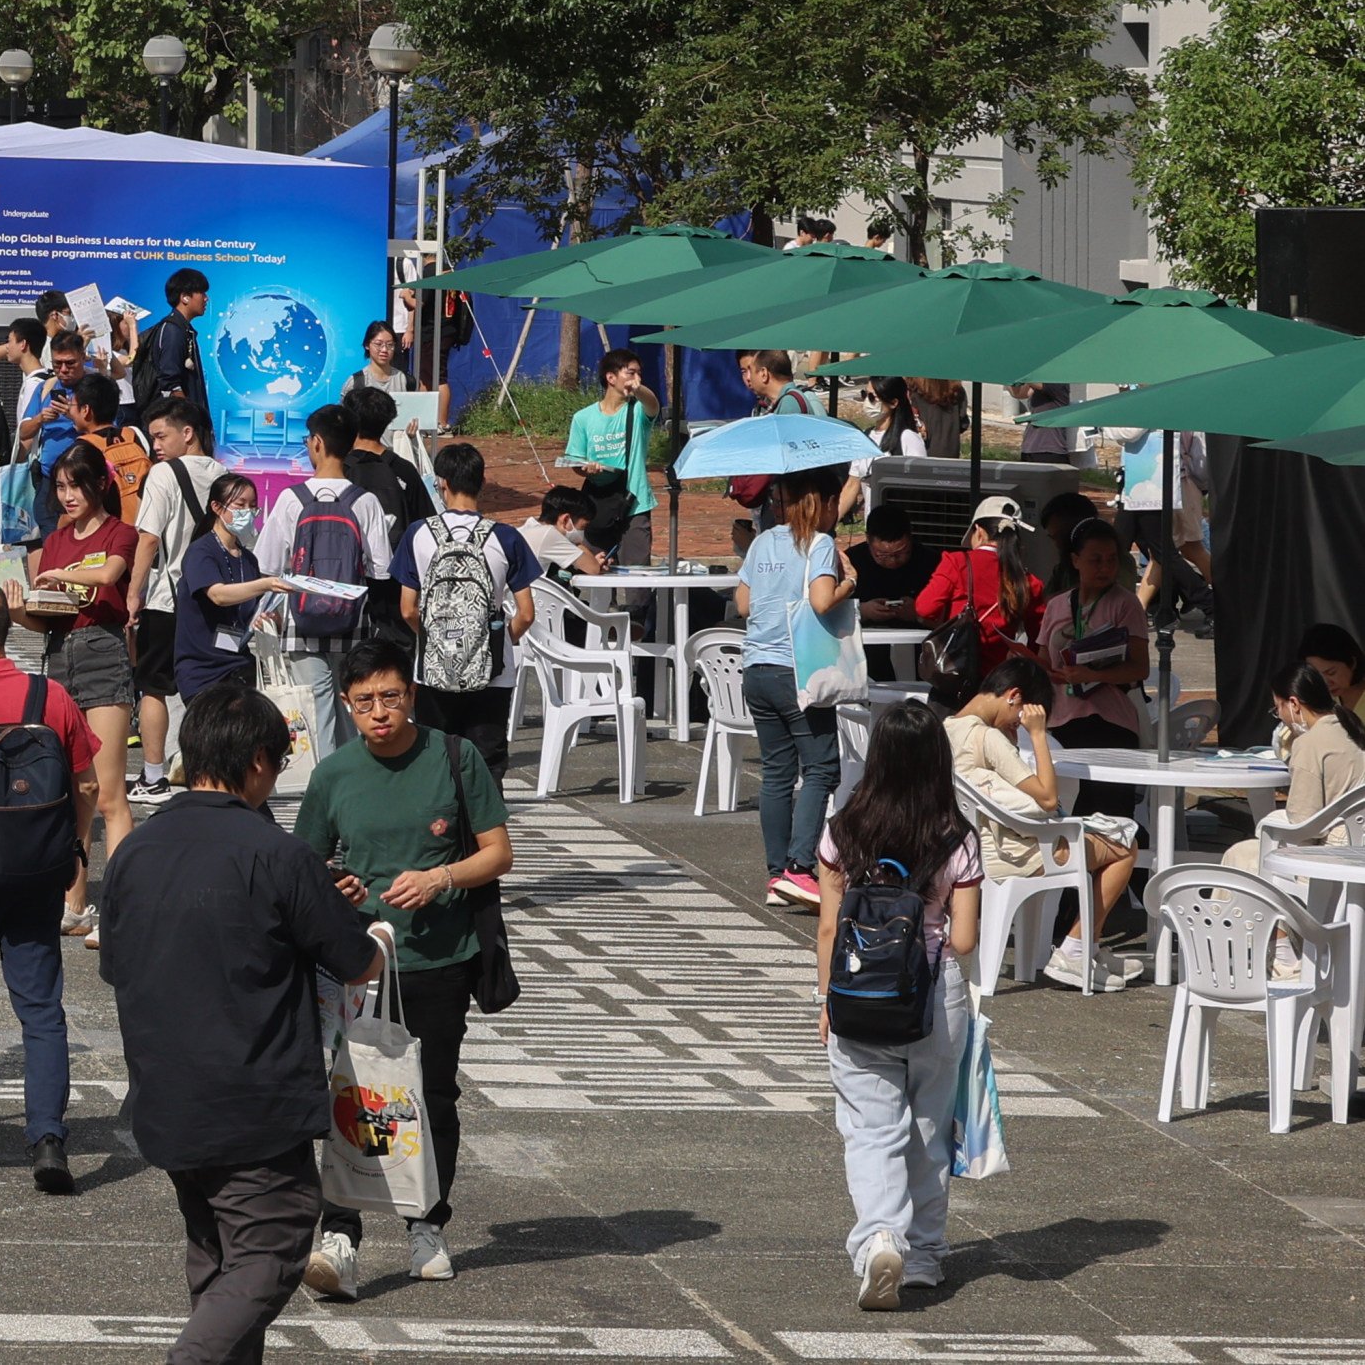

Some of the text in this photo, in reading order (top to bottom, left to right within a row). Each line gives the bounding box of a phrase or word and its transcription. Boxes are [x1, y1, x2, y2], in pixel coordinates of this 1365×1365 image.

[3, 210, 49, 219] Undergraduate
[20, 234, 53, 243] Global
[56, 235, 101, 245] Business
[104, 236, 144, 246] Leaders
[147, 237, 160, 246] for
[163, 237, 181, 247] the
[183, 238, 212, 248] Asian
[214, 239, 256, 251] Century
[20, 248, 49, 257] these
[52, 249, 118, 260] programmes
[121, 251, 131, 259] at
[133, 251, 164, 260] CUHK
[167, 251, 212, 261] Business
[214, 252, 250, 262] School
[252, 253, 286, 265] Today!
[593, 434, 604, 442] Go
[595, 444, 605, 452] Be
[757, 562, 786, 574] STAFF
[331, 1075, 409, 1105] CUHK
